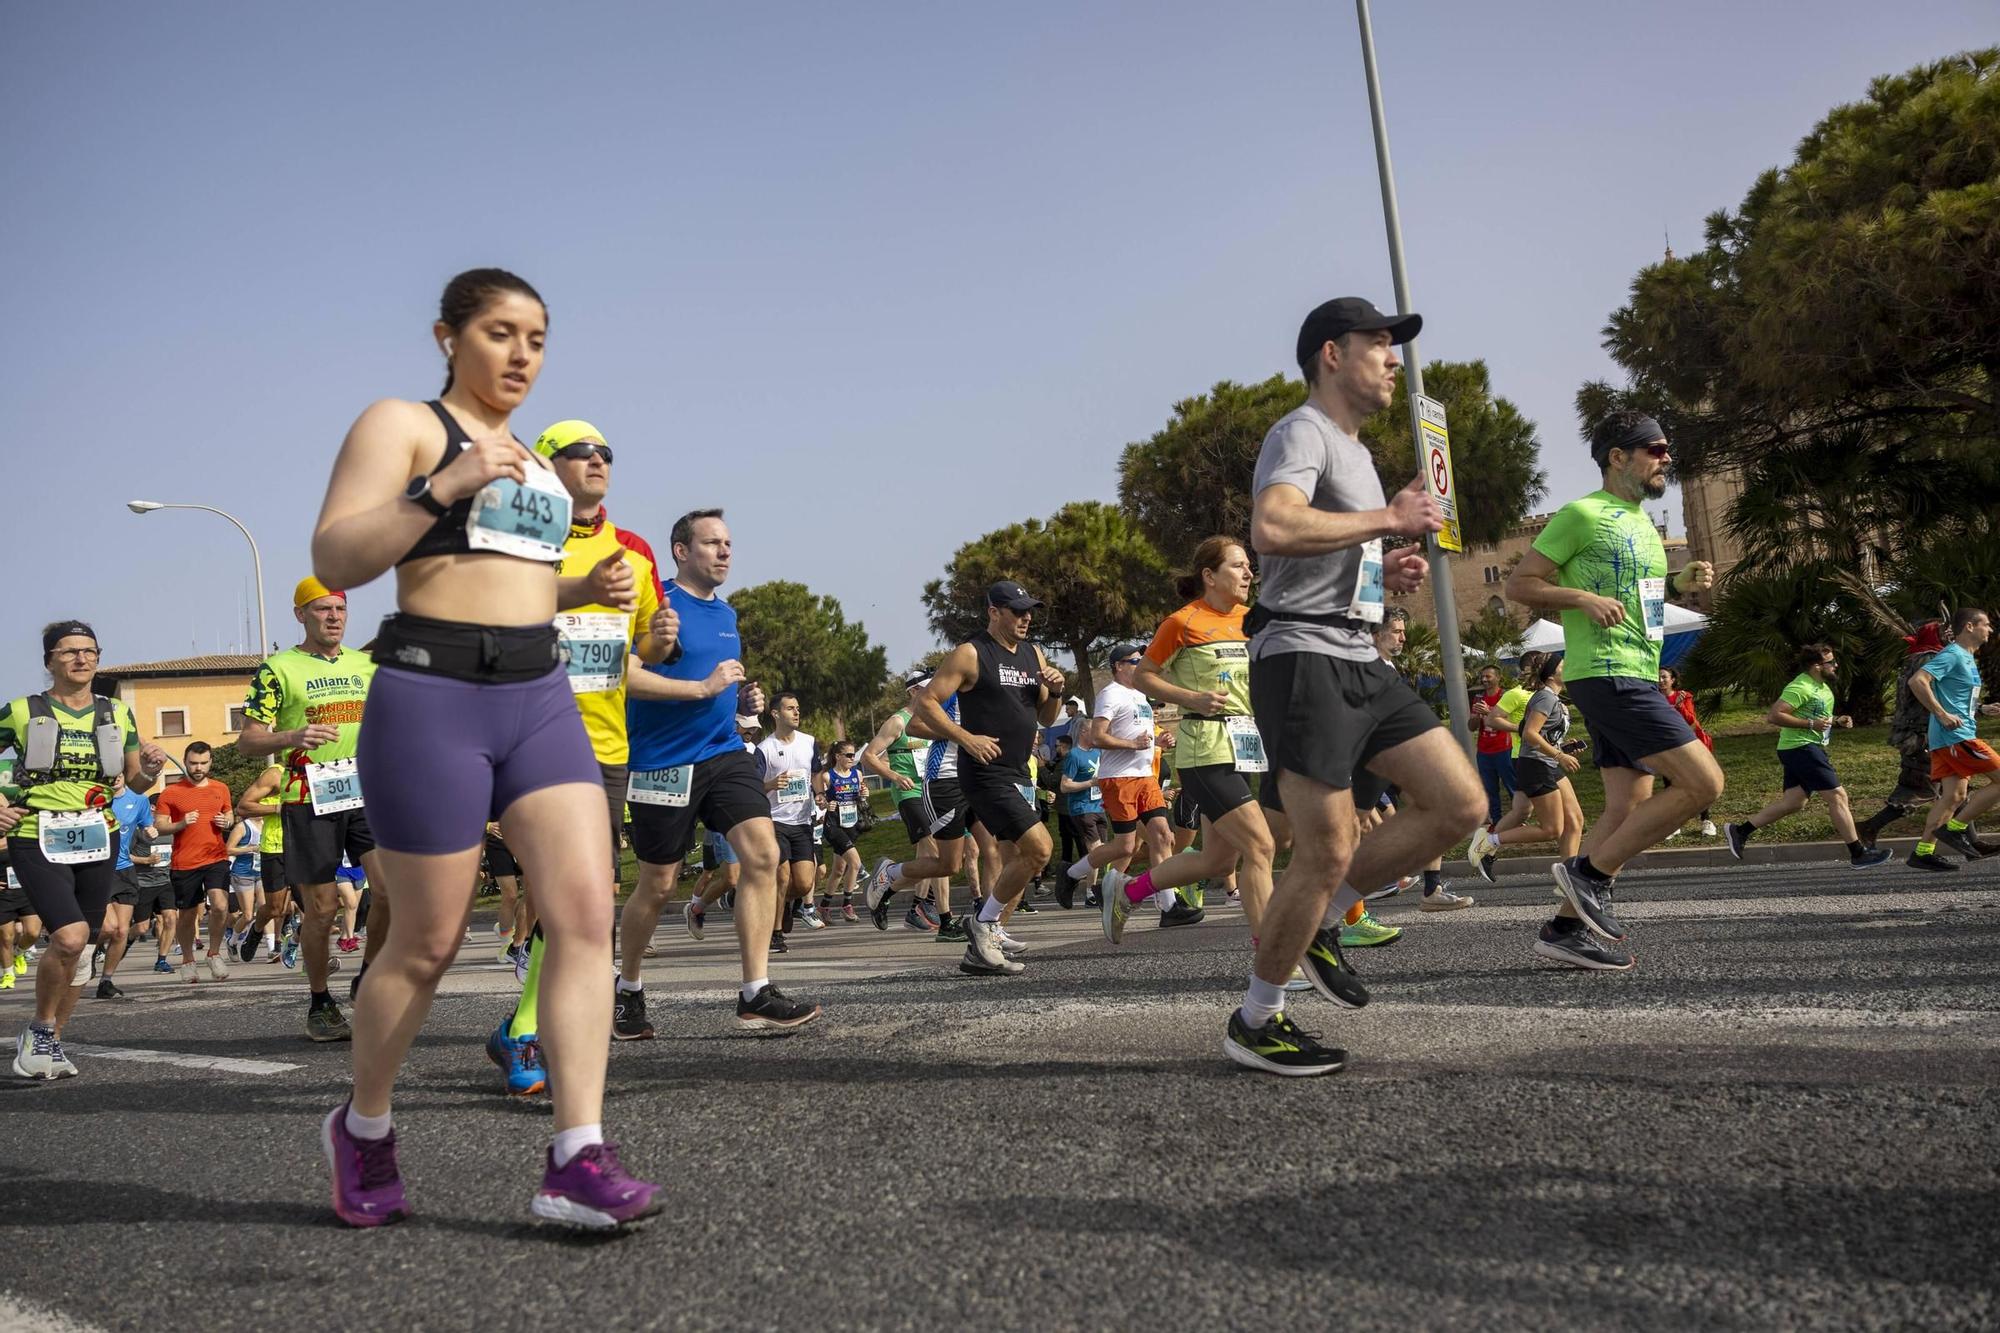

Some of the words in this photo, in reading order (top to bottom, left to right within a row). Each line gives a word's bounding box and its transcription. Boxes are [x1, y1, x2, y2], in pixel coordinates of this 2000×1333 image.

[511, 488, 553, 524] 443
[566, 615, 582, 626] 31
[580, 643, 612, 664] 790
[306, 677, 351, 691] Allianz
[304, 700, 366, 717] SANDBO
[644, 768, 680, 784] 1083
[327, 778, 352, 794] 501
[786, 781, 803, 792] 016
[66, 829, 86, 844] 91
